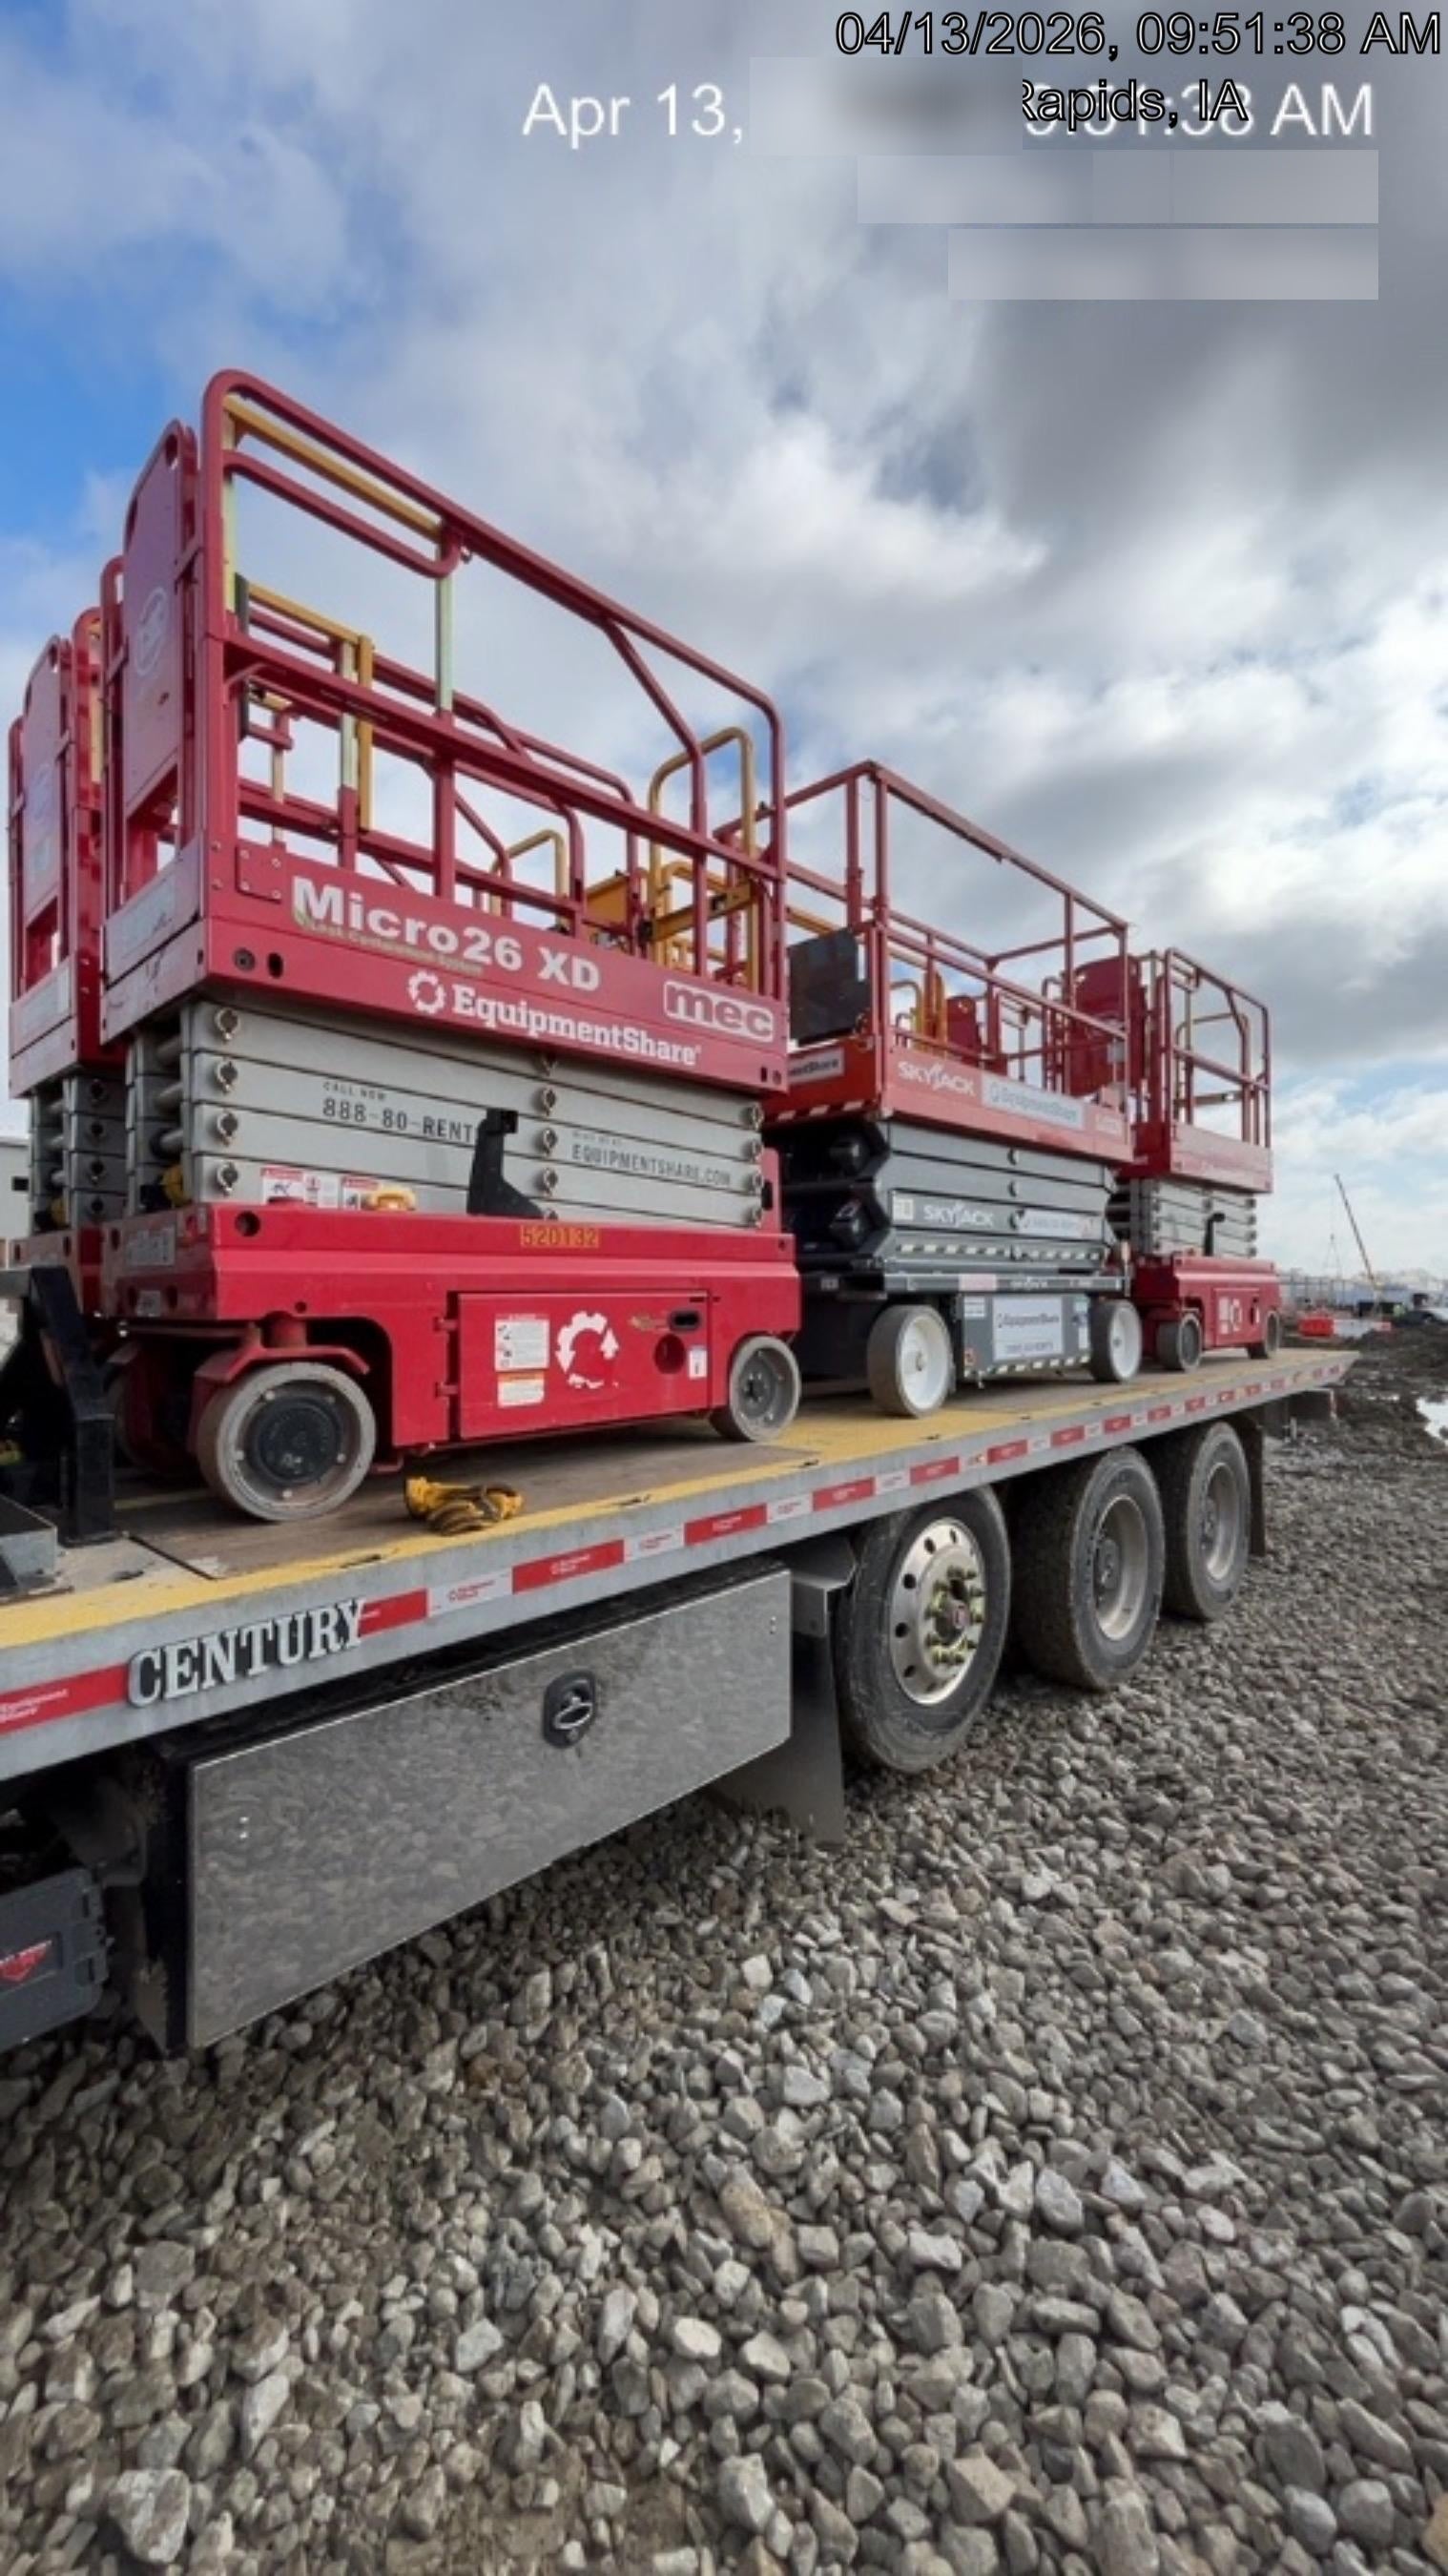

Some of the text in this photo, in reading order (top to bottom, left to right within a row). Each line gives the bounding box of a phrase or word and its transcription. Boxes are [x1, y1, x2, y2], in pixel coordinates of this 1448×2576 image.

[292, 876, 523, 971] Micro26
[537, 946, 600, 991] XD
[452, 984, 695, 1066] EquipmentShare
[665, 983, 773, 1039] mec
[322, 1081, 353, 1096] CALL
[898, 1061, 977, 1096] SKYJACK
[322, 1097, 473, 1143] 888-80-RENT
[922, 1202, 995, 1228] SKYJACK
[128, 1597, 367, 1707] CENTURY
